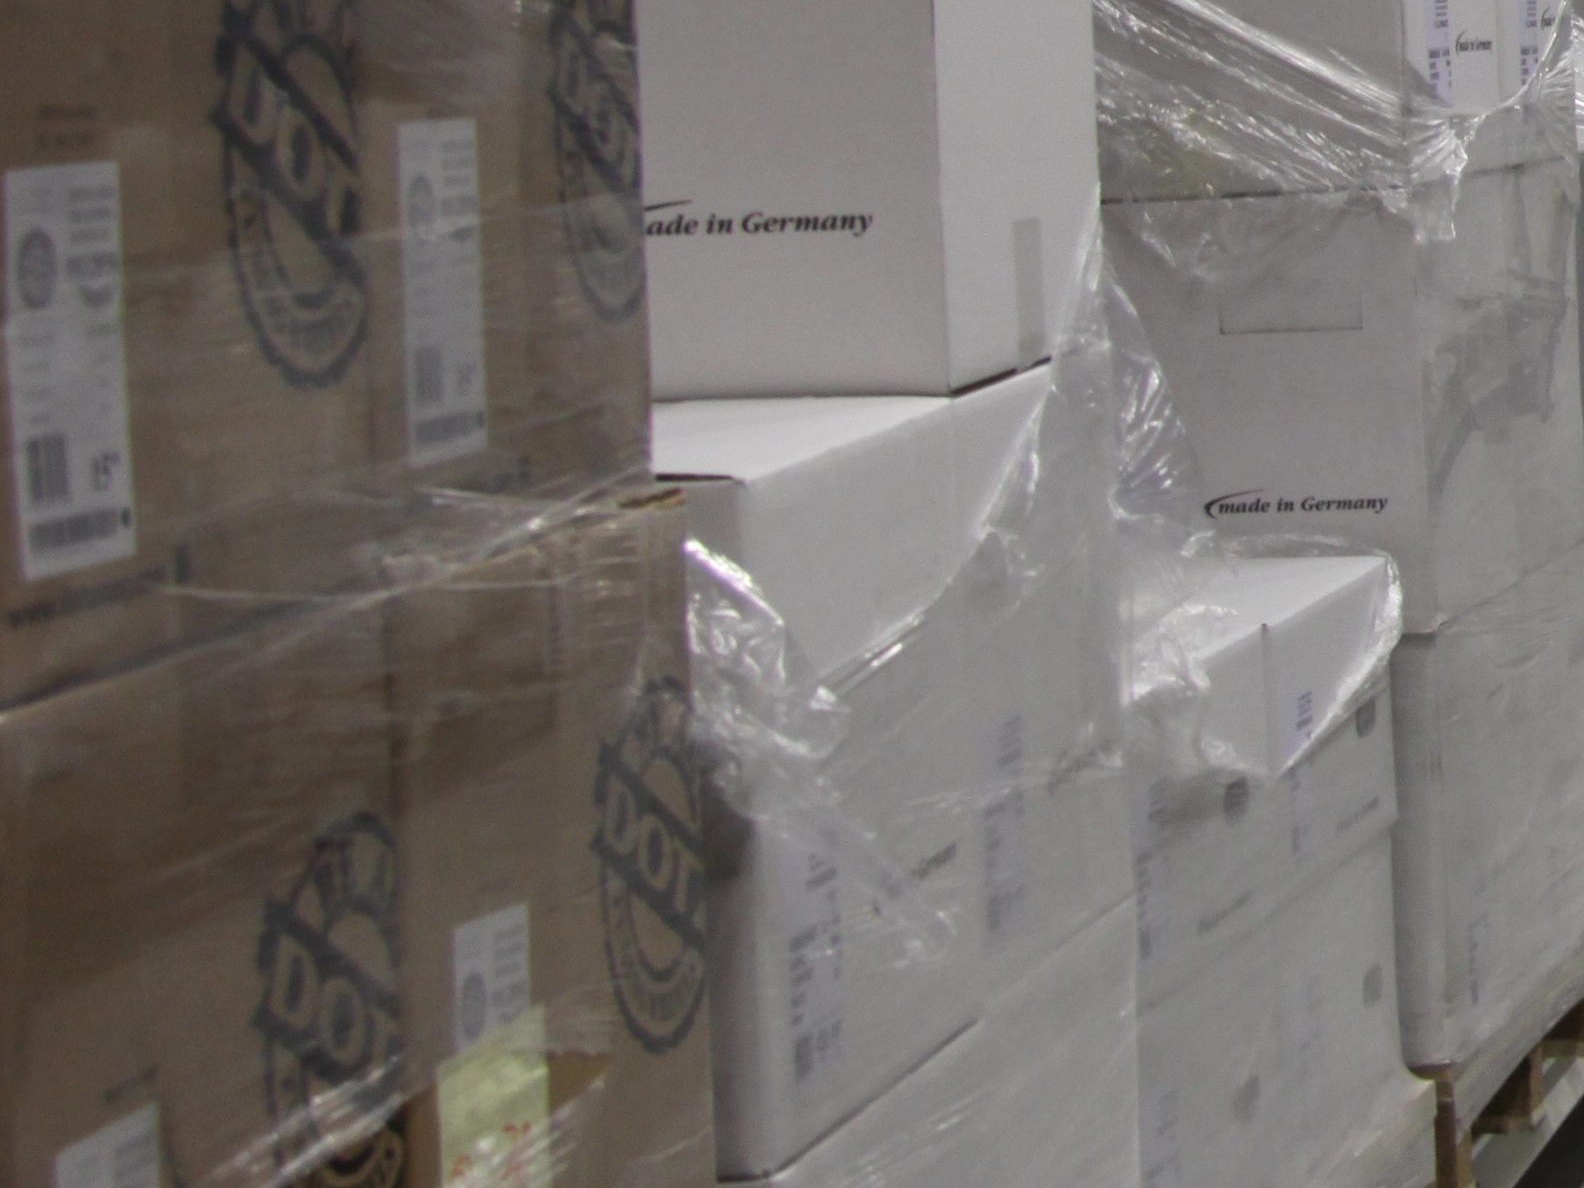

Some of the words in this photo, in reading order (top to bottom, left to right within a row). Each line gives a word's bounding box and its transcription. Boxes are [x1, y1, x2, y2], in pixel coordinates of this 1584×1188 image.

[646, 213, 699, 236] ade
[706, 213, 734, 235] in
[742, 211, 874, 238] Germany
[1218, 497, 1271, 515] made
[1277, 497, 1295, 513] in
[1301, 496, 1388, 515] Germany
